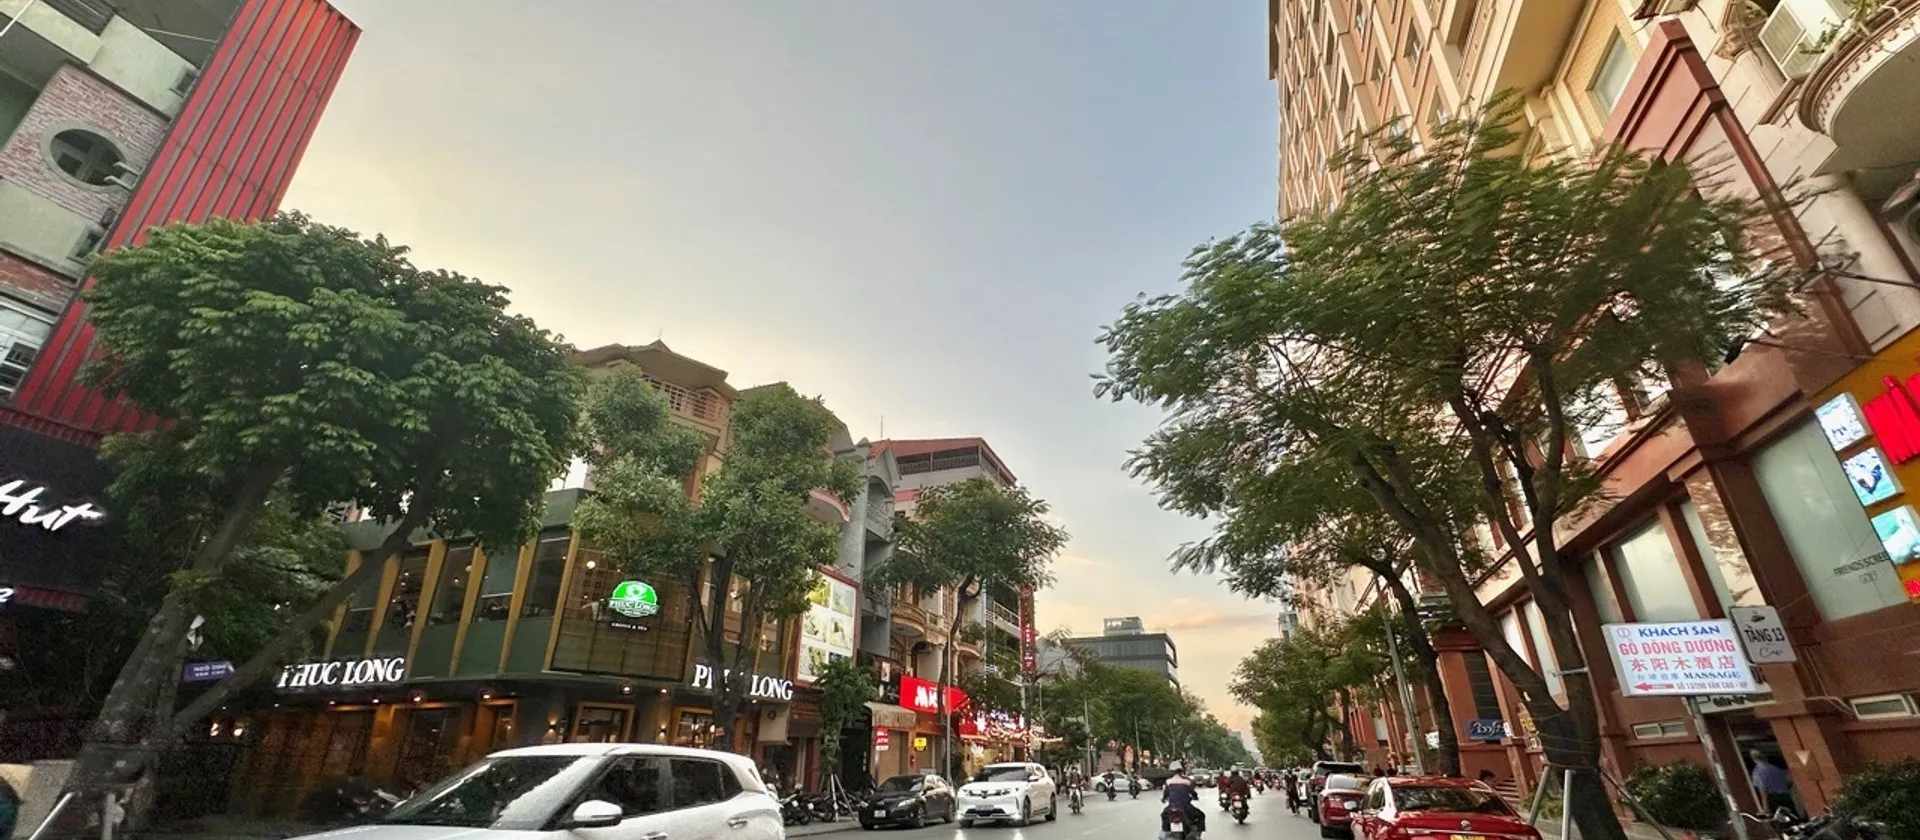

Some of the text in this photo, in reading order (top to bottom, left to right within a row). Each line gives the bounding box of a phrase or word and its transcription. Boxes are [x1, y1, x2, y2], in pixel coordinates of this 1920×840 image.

[0, 480, 105, 531] Hut
[1771, 627, 1785, 641] 13
[341, 657, 405, 684] LONG
[1683, 672, 1741, 680] MASSAGE
[750, 674, 794, 700] LONG
